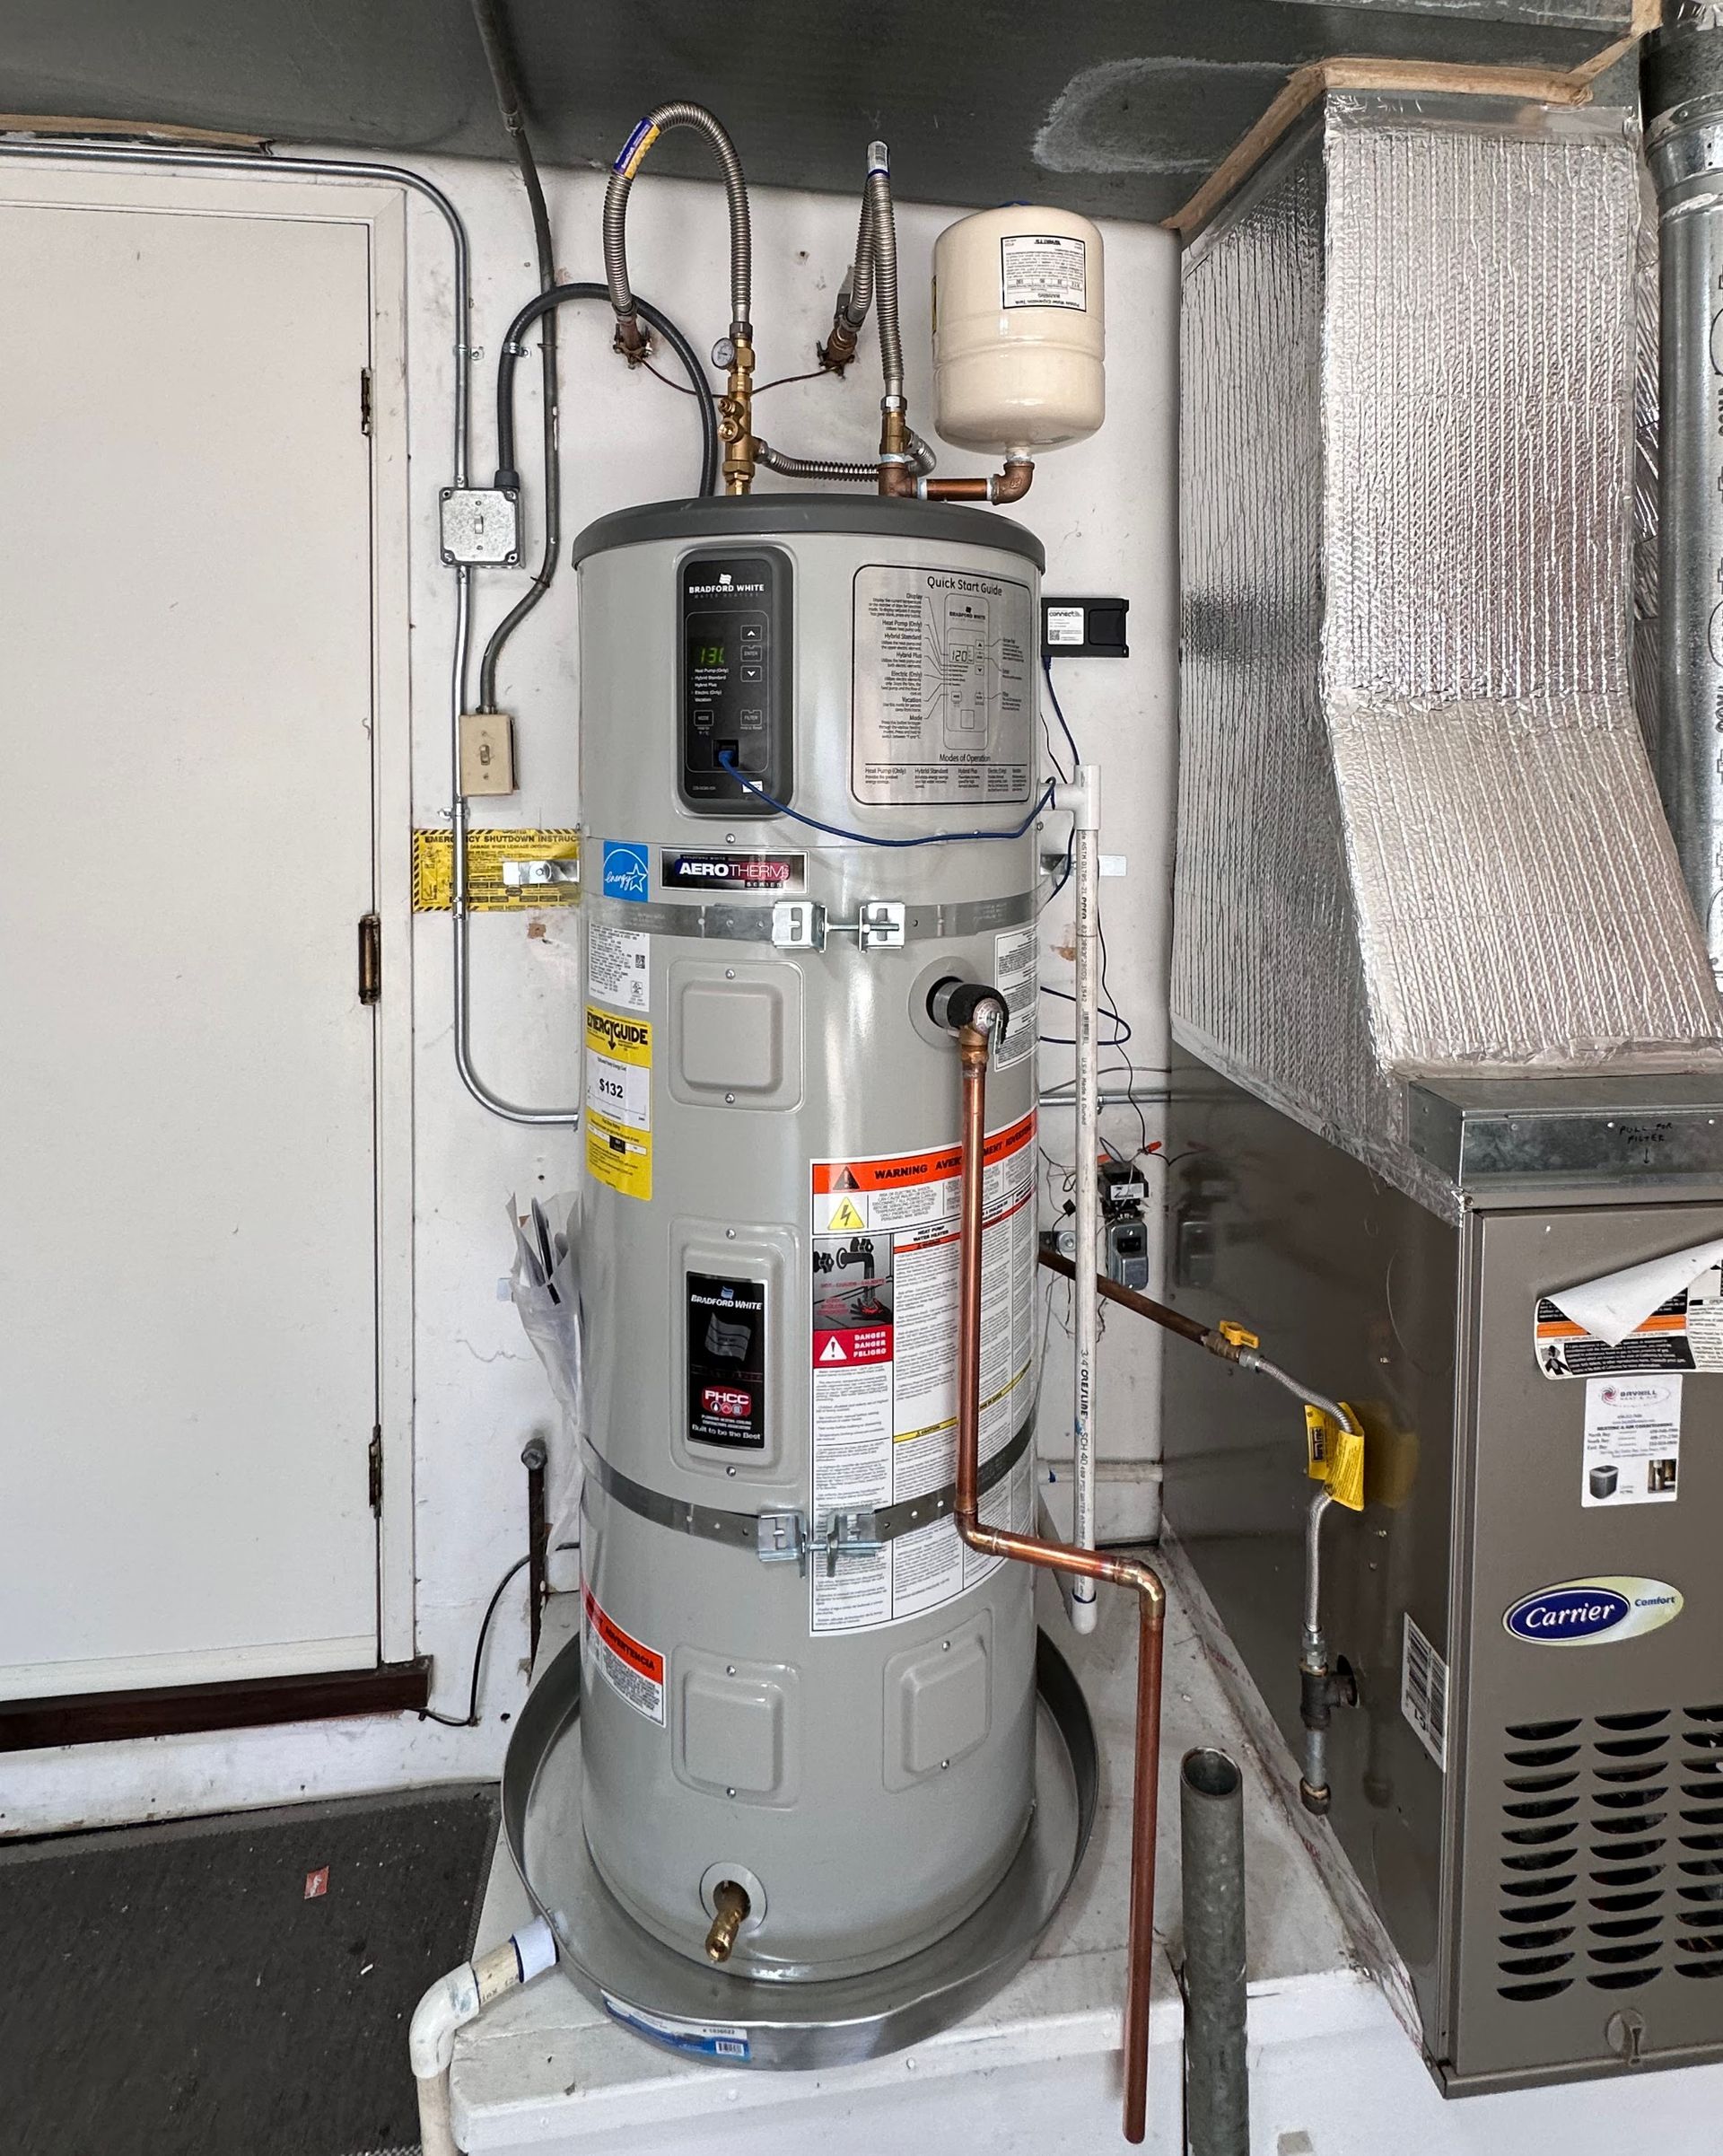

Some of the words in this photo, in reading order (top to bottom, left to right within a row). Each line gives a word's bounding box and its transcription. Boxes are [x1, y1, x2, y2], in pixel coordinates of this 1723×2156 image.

[689, 584, 734, 593] BRADFORD
[927, 575, 955, 590] Quick
[958, 579, 979, 592] Start
[981, 583, 1002, 596] Guide
[906, 592, 923, 600] Display
[895, 619, 908, 627] Pump
[909, 620, 923, 628] (Only)
[951, 649, 967, 662] 120
[940, 753, 957, 762] Modes
[958, 753, 966, 762] of
[966, 754, 991, 763] Operation
[679, 862, 784, 879] AEROTHERM
[605, 873, 632, 890] energy
[599, 1078, 624, 1099] $132
[1620, 1126, 1646, 1135] PULL
[1628, 1135, 1665, 1144] FILTER
[874, 1164, 928, 1179] WARNING
[913, 1234, 930, 1242] WATER
[931, 1230, 949, 1240] HEATER
[917, 1227, 930, 1235] HEAT
[931, 1225, 945, 1233] PUMP
[691, 1294, 734, 1308] BRADFORD
[735, 1300, 763, 1310] WHITE
[854, 1331, 886, 1341] DANGER
[854, 1340, 886, 1349] DANGER
[853, 1348, 887, 1358] PELIGRO
[704, 1390, 749, 1405] PHCC
[692, 1424, 707, 1433] Built
[717, 1428, 728, 1436] be
[729, 1429, 741, 1438] the
[742, 1431, 761, 1440] Best
[1080, 1431, 1089, 1450] SCH
[1080, 1452, 1089, 1465] 40
[1526, 1602, 1615, 1628] Carrier
[1634, 1596, 1675, 1607] Comfort
